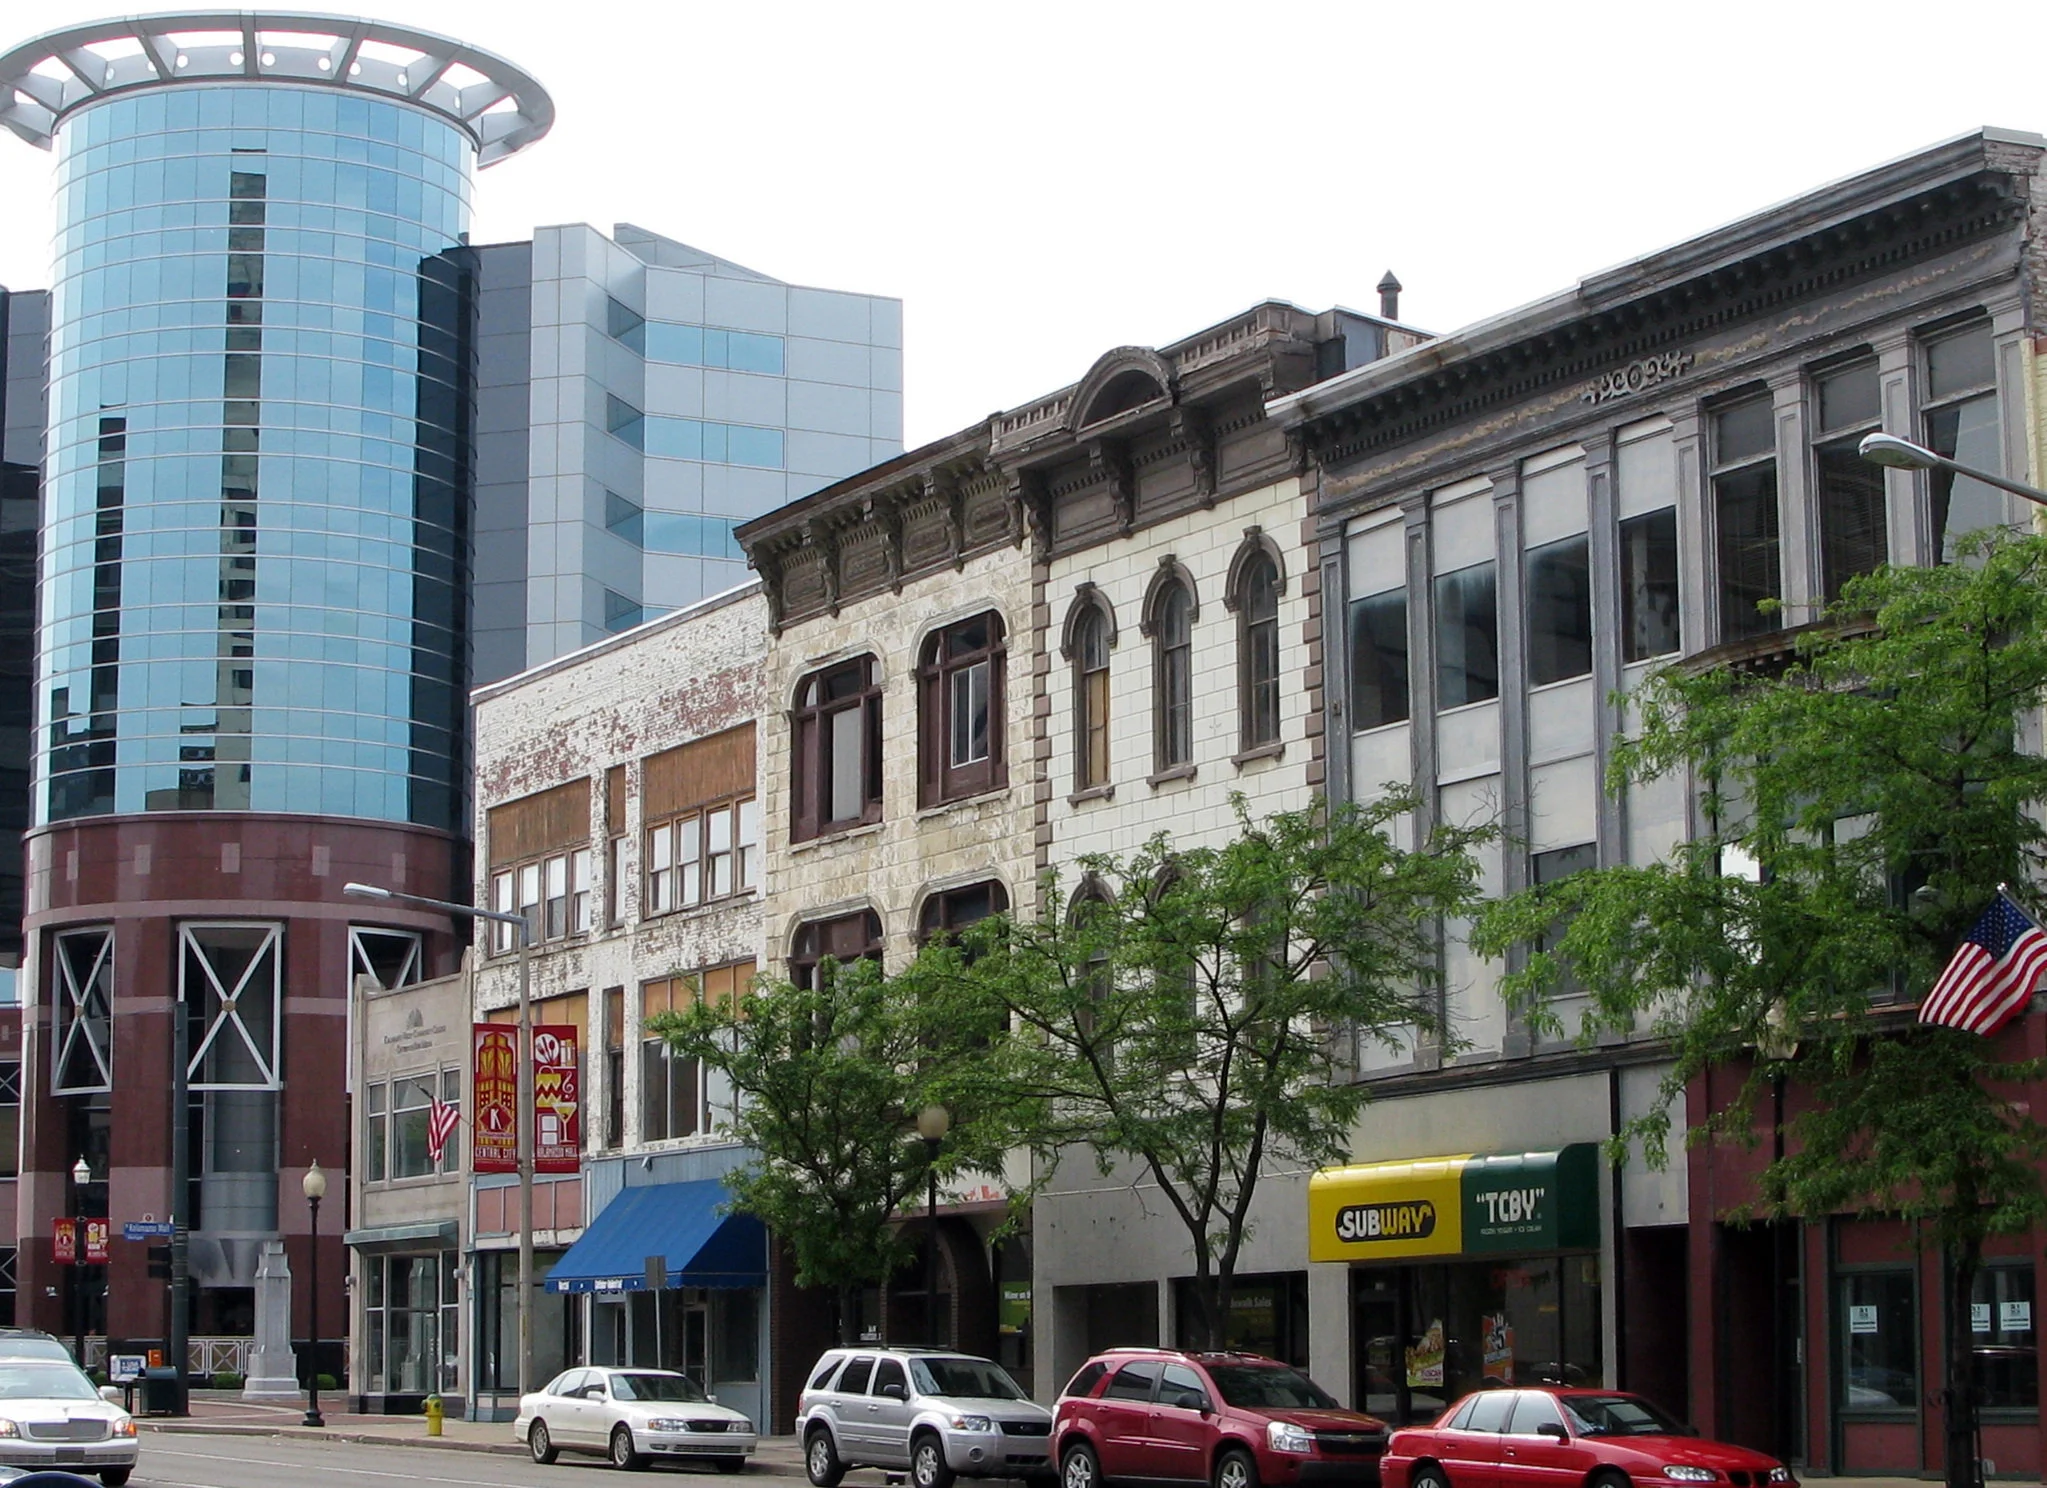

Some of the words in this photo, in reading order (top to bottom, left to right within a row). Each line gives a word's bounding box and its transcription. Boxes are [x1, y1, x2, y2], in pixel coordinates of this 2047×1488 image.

[490, 1108, 502, 1130] K
[475, 1147, 502, 1159] CENTRAL
[503, 1148, 517, 1159] CITY
[1338, 1205, 1433, 1238] SUBWAY
